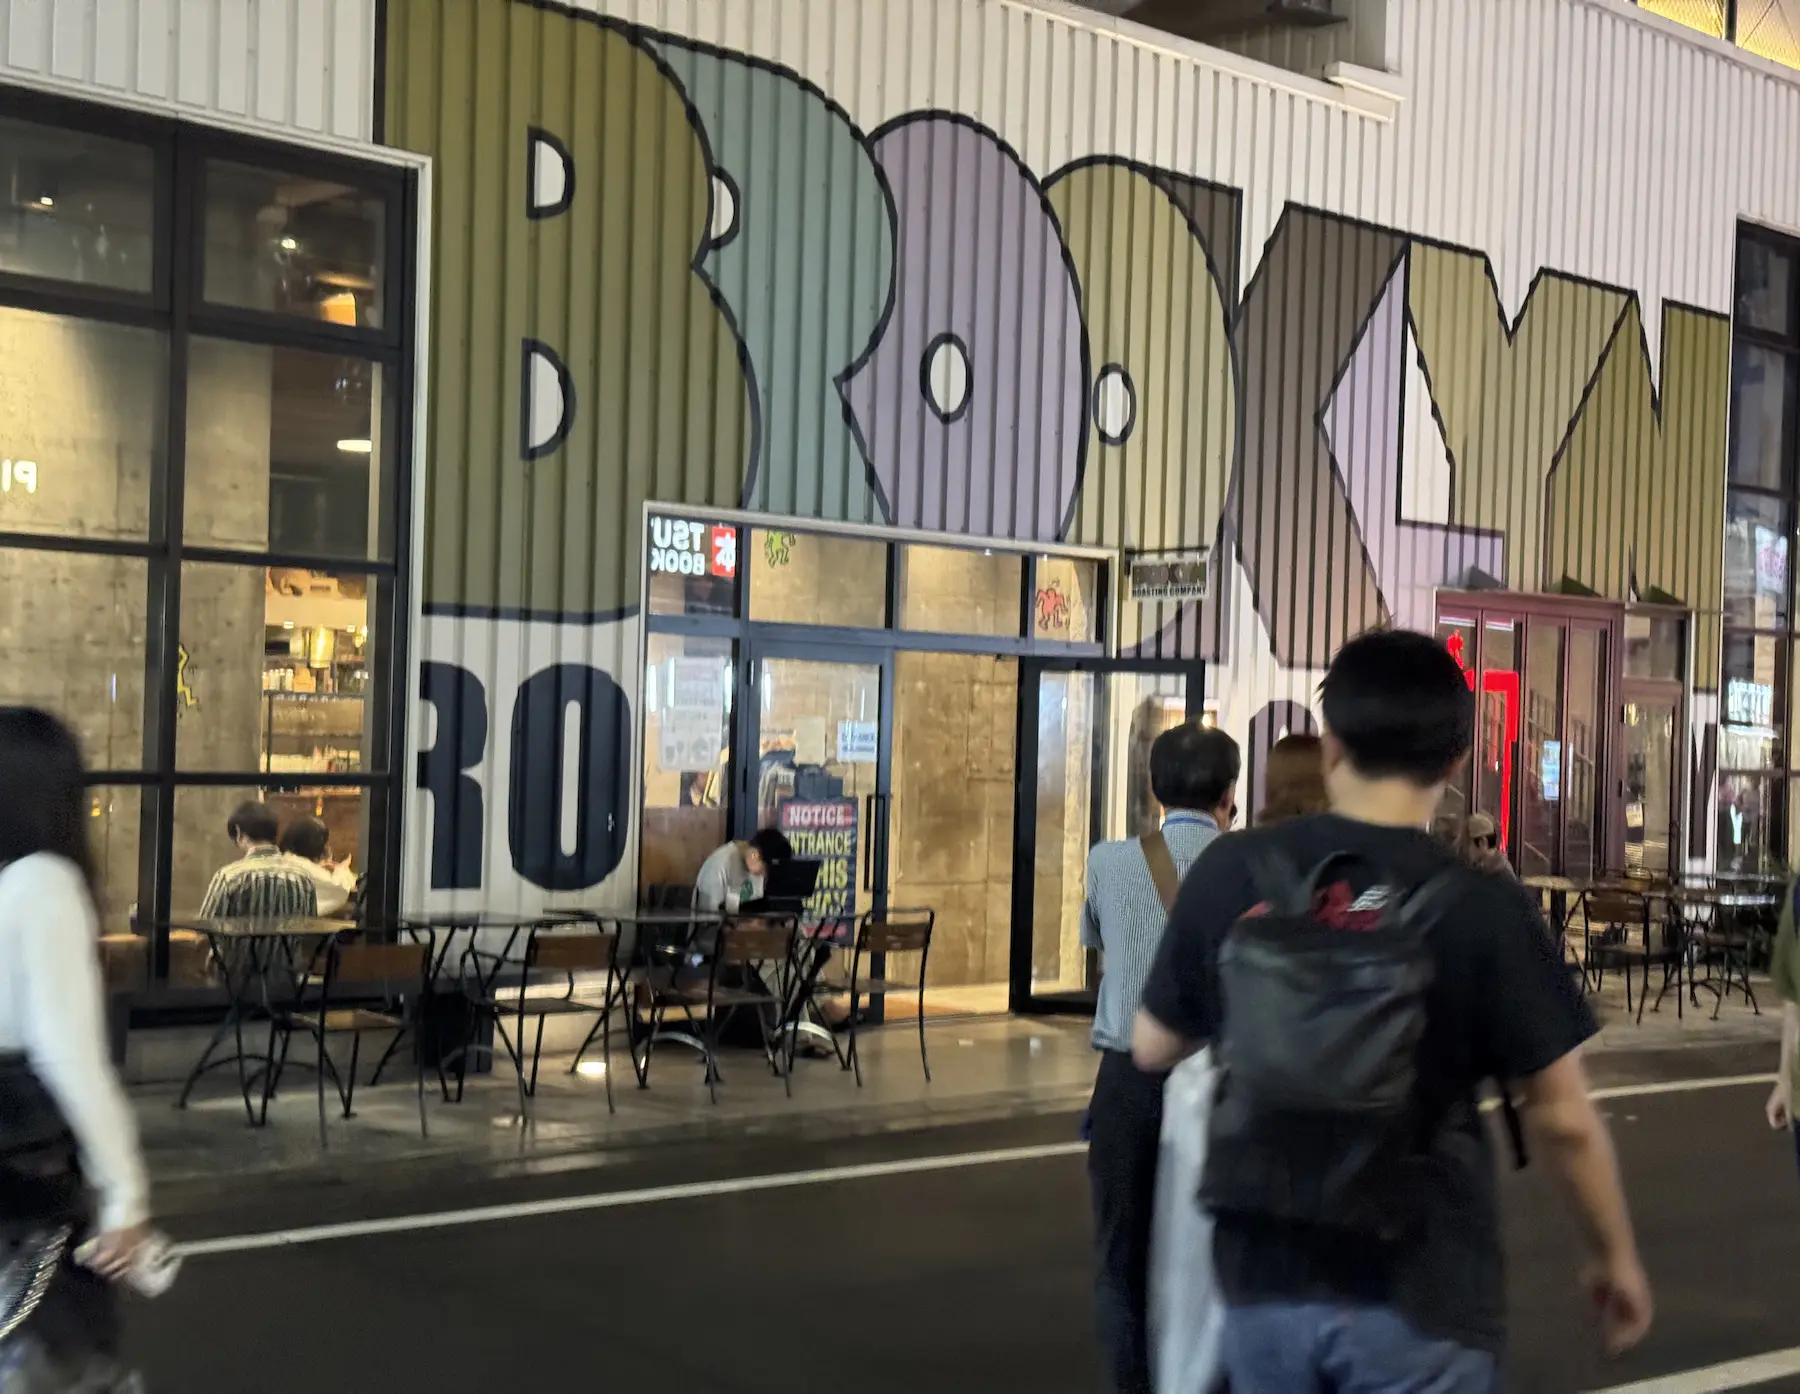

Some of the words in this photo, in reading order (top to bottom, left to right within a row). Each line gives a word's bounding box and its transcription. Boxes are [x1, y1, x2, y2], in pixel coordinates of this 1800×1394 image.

[1169, 585, 1206, 596] COMPANY
[789, 804, 846, 827] NOTICE
[815, 857, 848, 889] HIS
